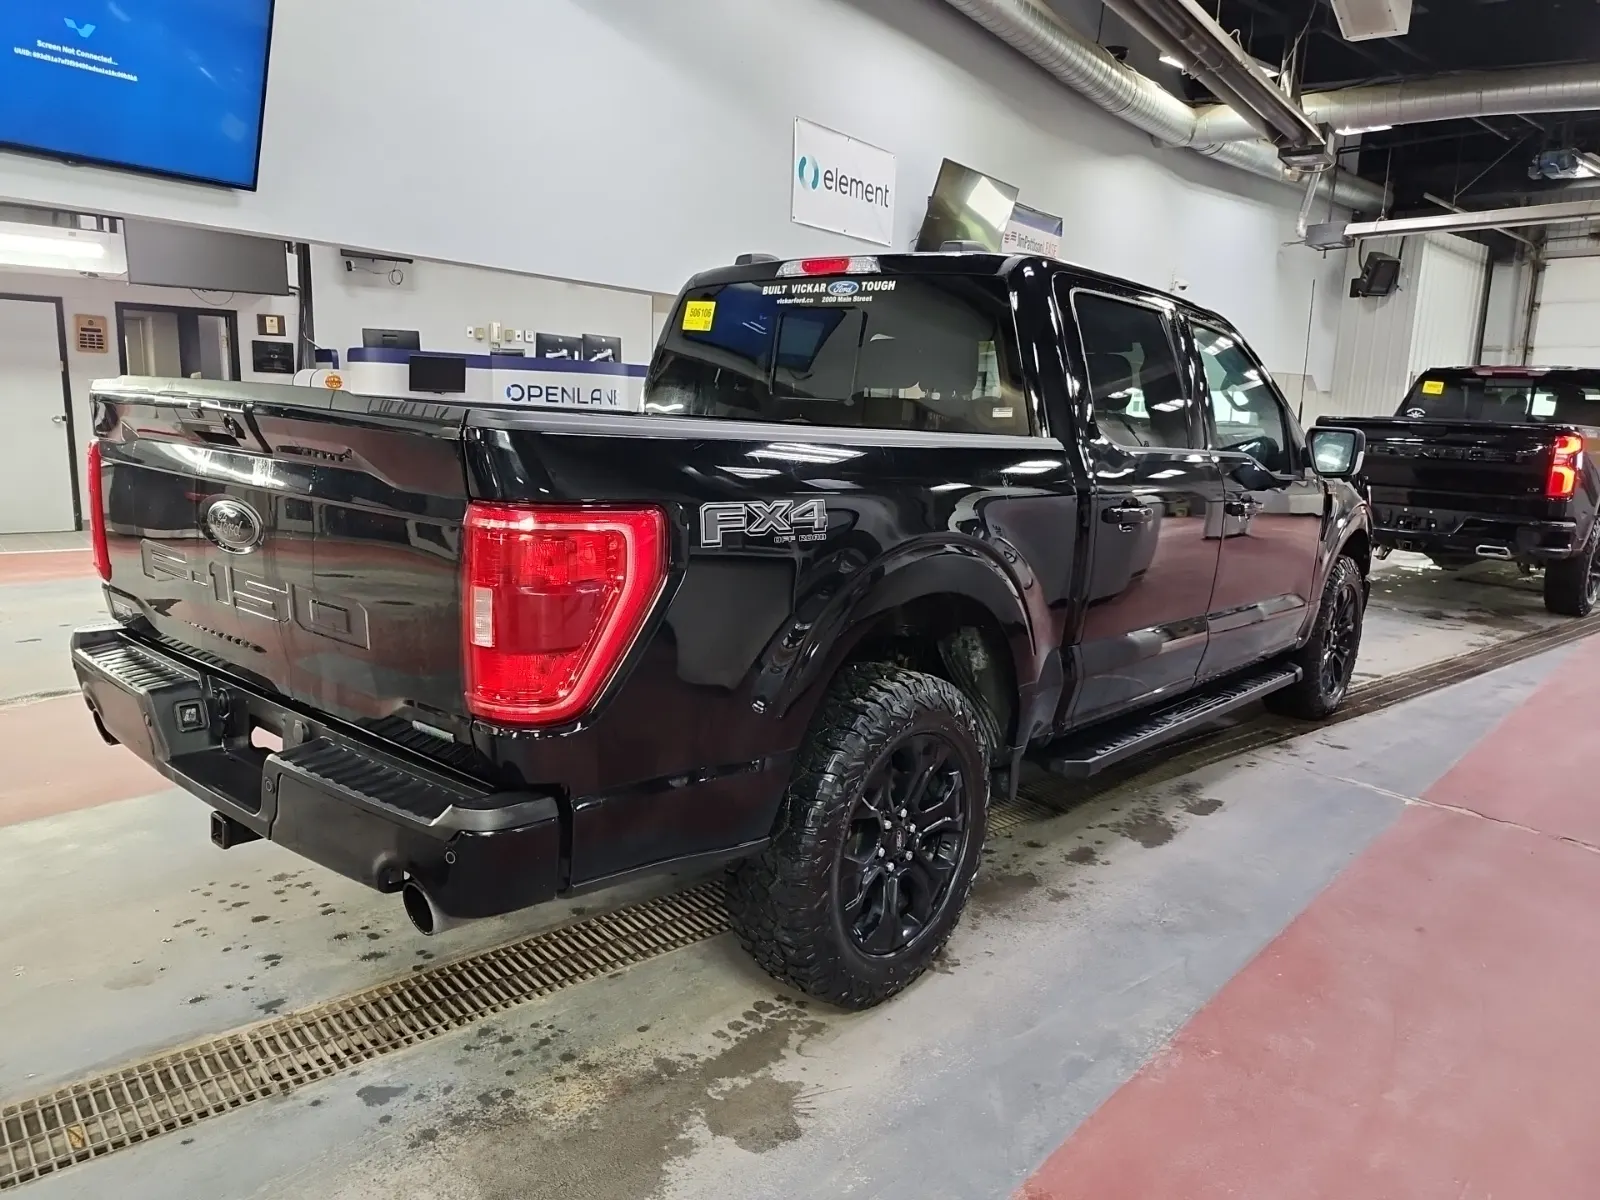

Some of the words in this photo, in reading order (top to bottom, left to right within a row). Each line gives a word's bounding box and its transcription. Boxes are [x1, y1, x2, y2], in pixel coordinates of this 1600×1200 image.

[13, 47, 32, 57] UUID:
[37, 39, 61, 52] Screen
[62, 46, 76, 55] Not
[76, 49, 119, 65] Connected...
[823, 168, 890, 208] element
[762, 285, 787, 295] BUILT
[791, 283, 826, 294] VICKAR
[861, 281, 896, 291] TOUGH
[776, 297, 814, 305] vickarford.ca
[837, 295, 852, 303] Main
[853, 295, 873, 303] Street
[700, 499, 828, 548] FX4
[774, 535, 796, 543] OFF
[799, 533, 827, 542] ROAD
[140, 538, 371, 650] F-150
